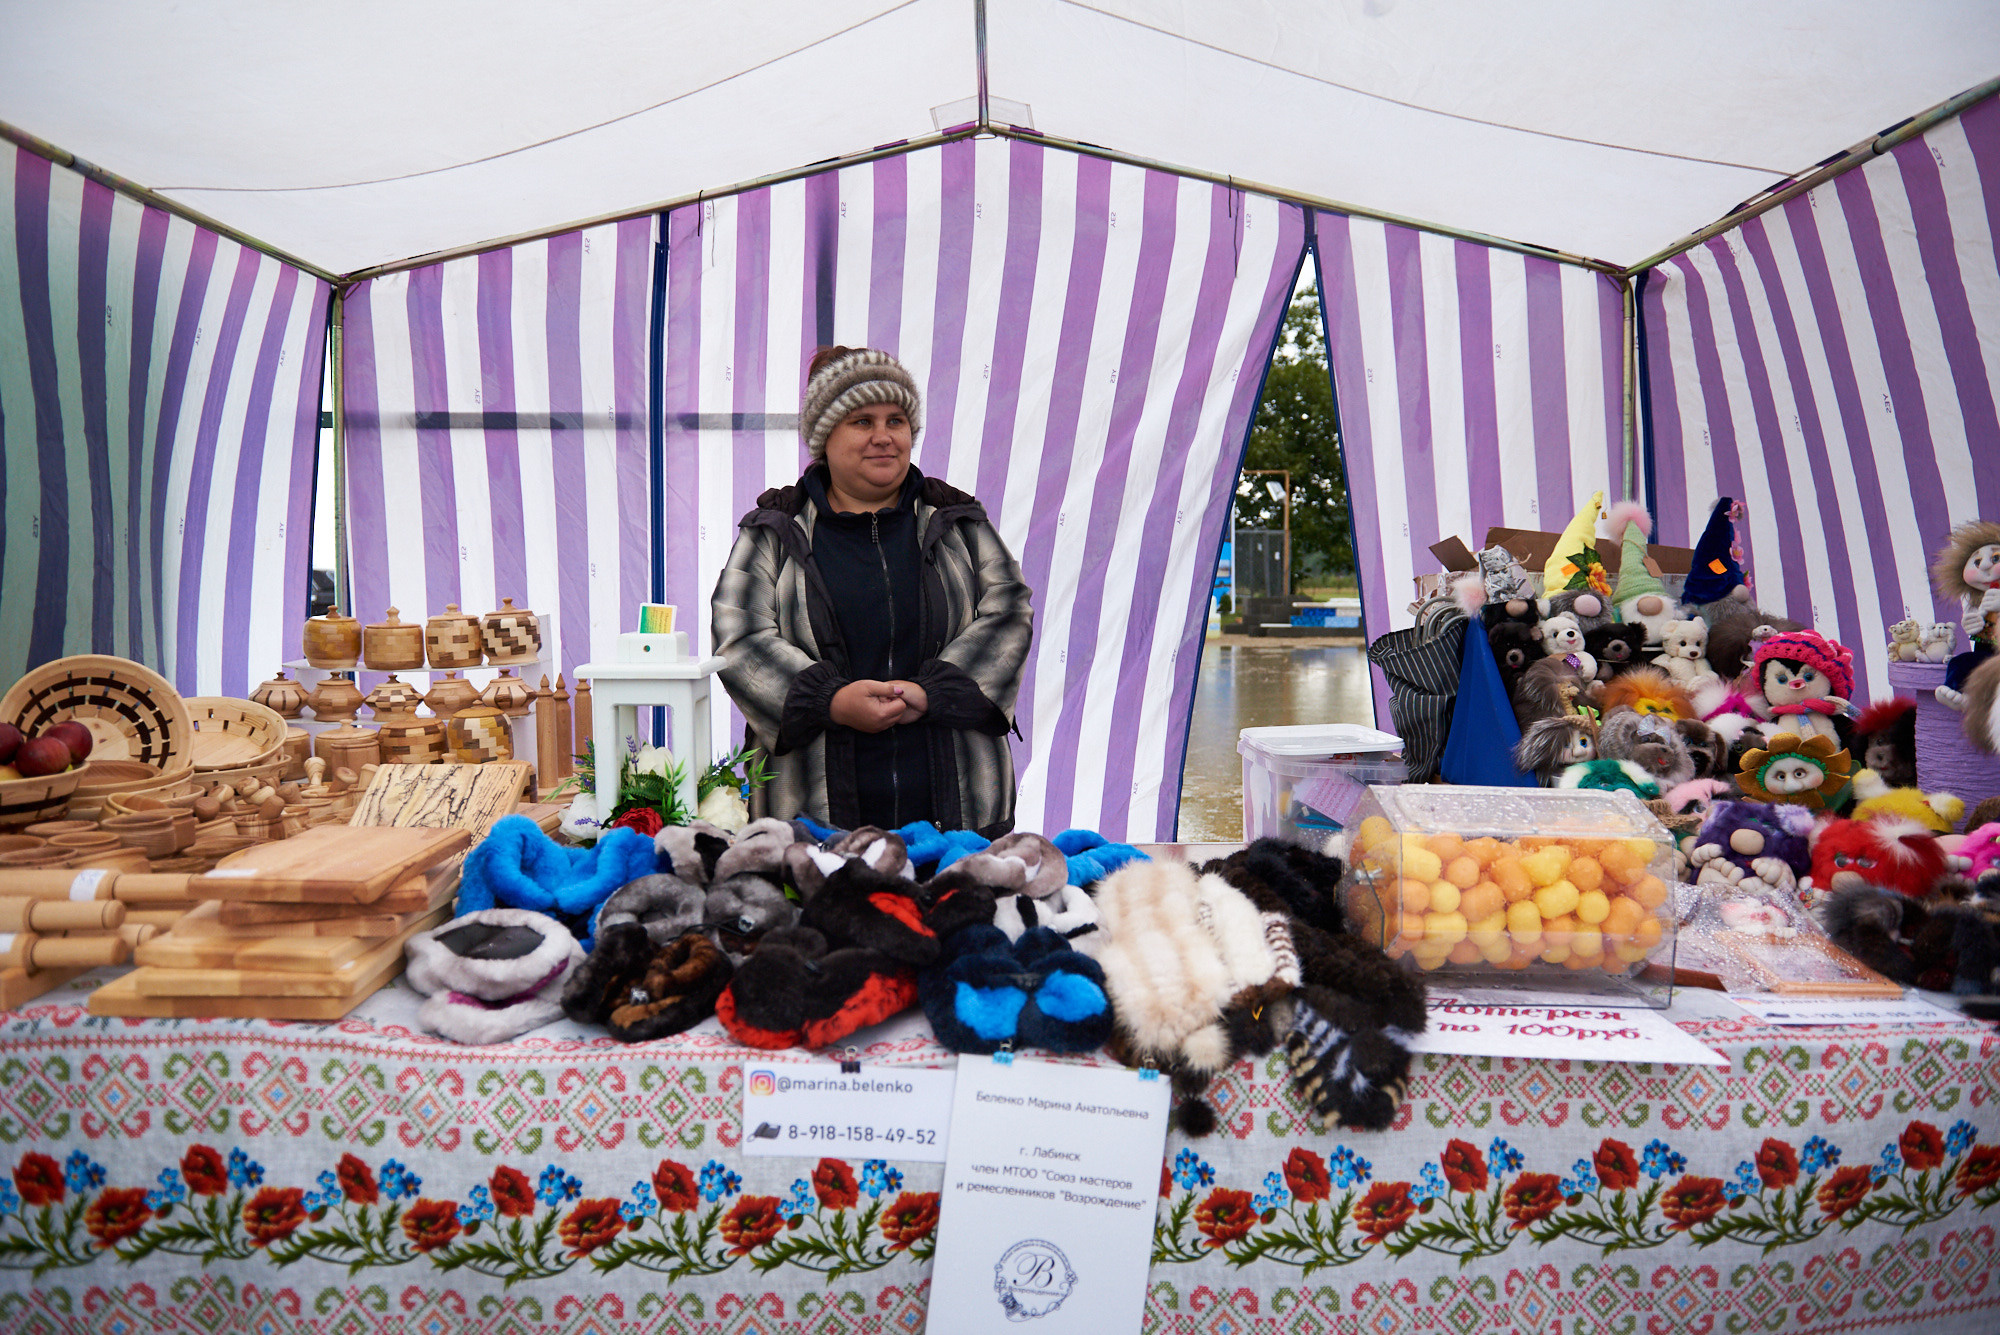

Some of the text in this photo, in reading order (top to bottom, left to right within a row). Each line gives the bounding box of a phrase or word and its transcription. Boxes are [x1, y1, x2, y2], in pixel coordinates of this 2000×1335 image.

[1426, 998, 1627, 1022] Лотерея
[1437, 1022, 1653, 1041] по 100руб.
[777, 1076, 914, 1094] @marina.belenko
[976, 1090, 1150, 1120] Беленко Марина Анатольевна
[787, 1124, 937, 1145] 8-918-158-49-52
[1019, 1146, 1082, 1162] г. Лабинск
[971, 1164, 1133, 1191] член МТОО "Союз мастеров
[955, 1181, 1148, 1211] и ремесленников "Возрождение"
